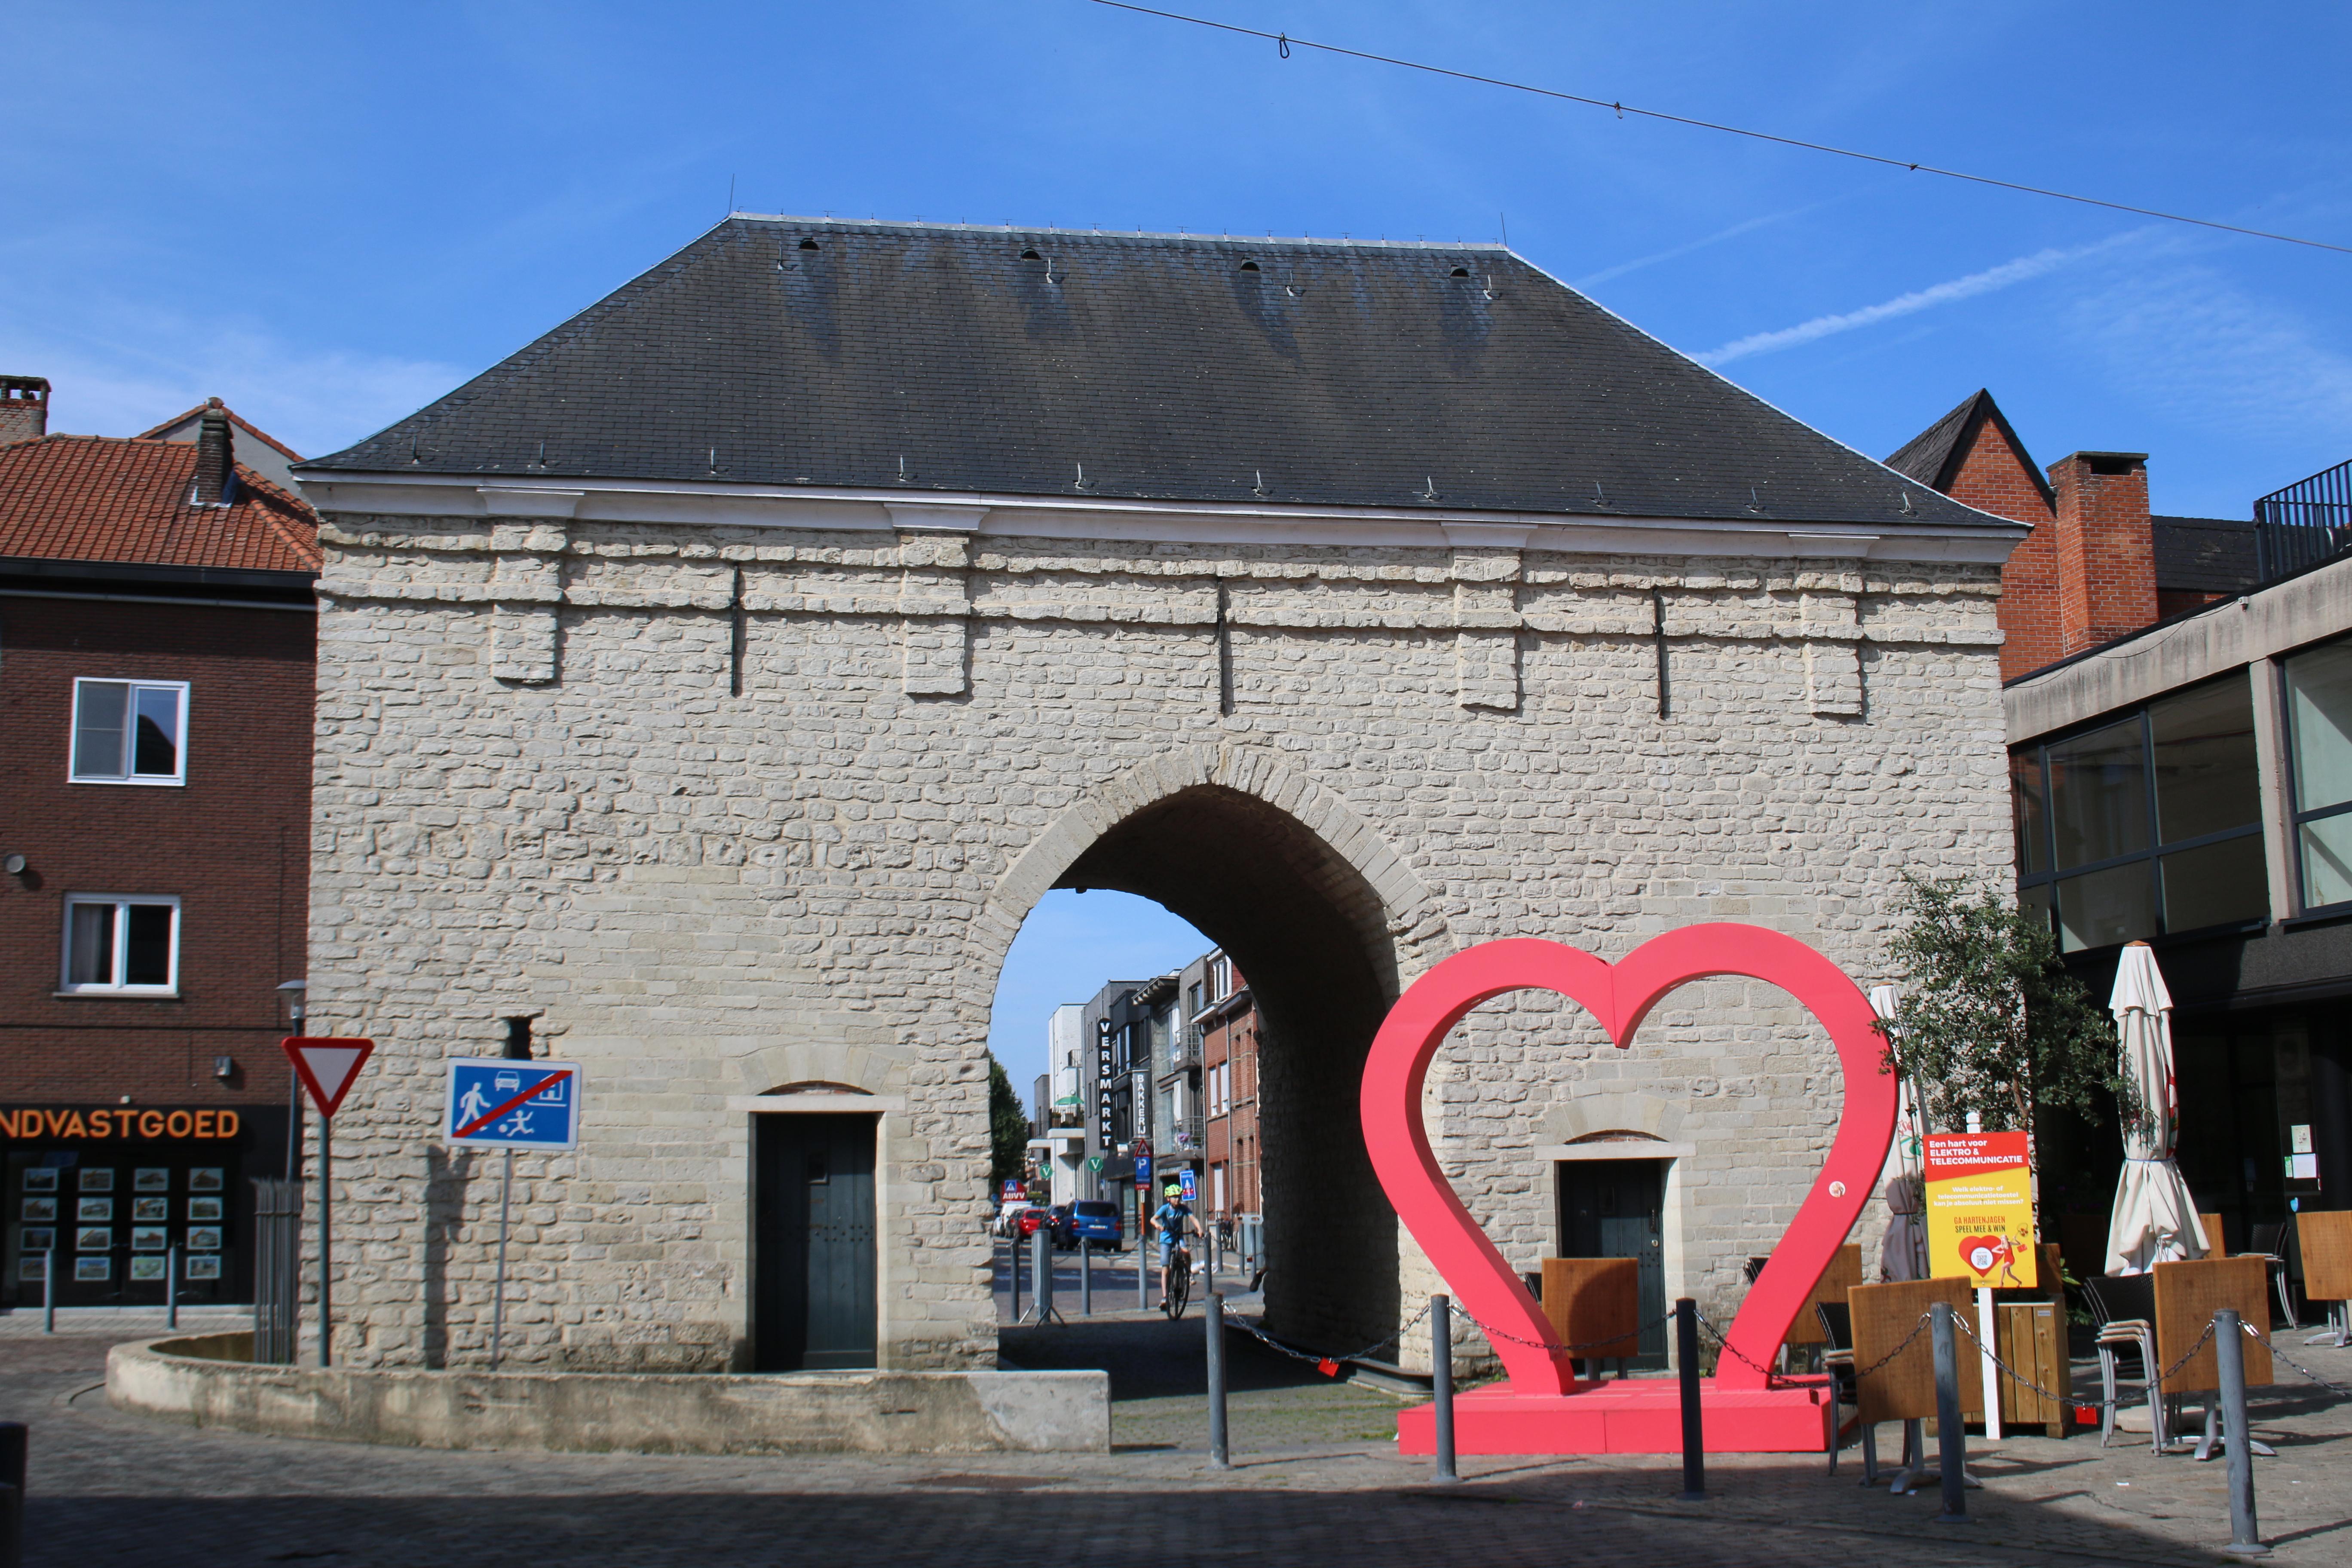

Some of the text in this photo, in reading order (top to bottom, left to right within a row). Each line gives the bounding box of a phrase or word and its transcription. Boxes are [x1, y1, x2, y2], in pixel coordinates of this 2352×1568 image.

[1099, 1022, 1112, 1146] VERSMARKT
[1137, 1075, 1146, 1134] BAKKERIJ
[1930, 1148, 1971, 1157] ELEKTRO
[1090, 1159, 1099, 1169] V
[1139, 1159, 1147, 1169] P
[1930, 1155, 2023, 1165] TELECOMMUNICATIE
[1042, 1167, 1050, 1176] V
